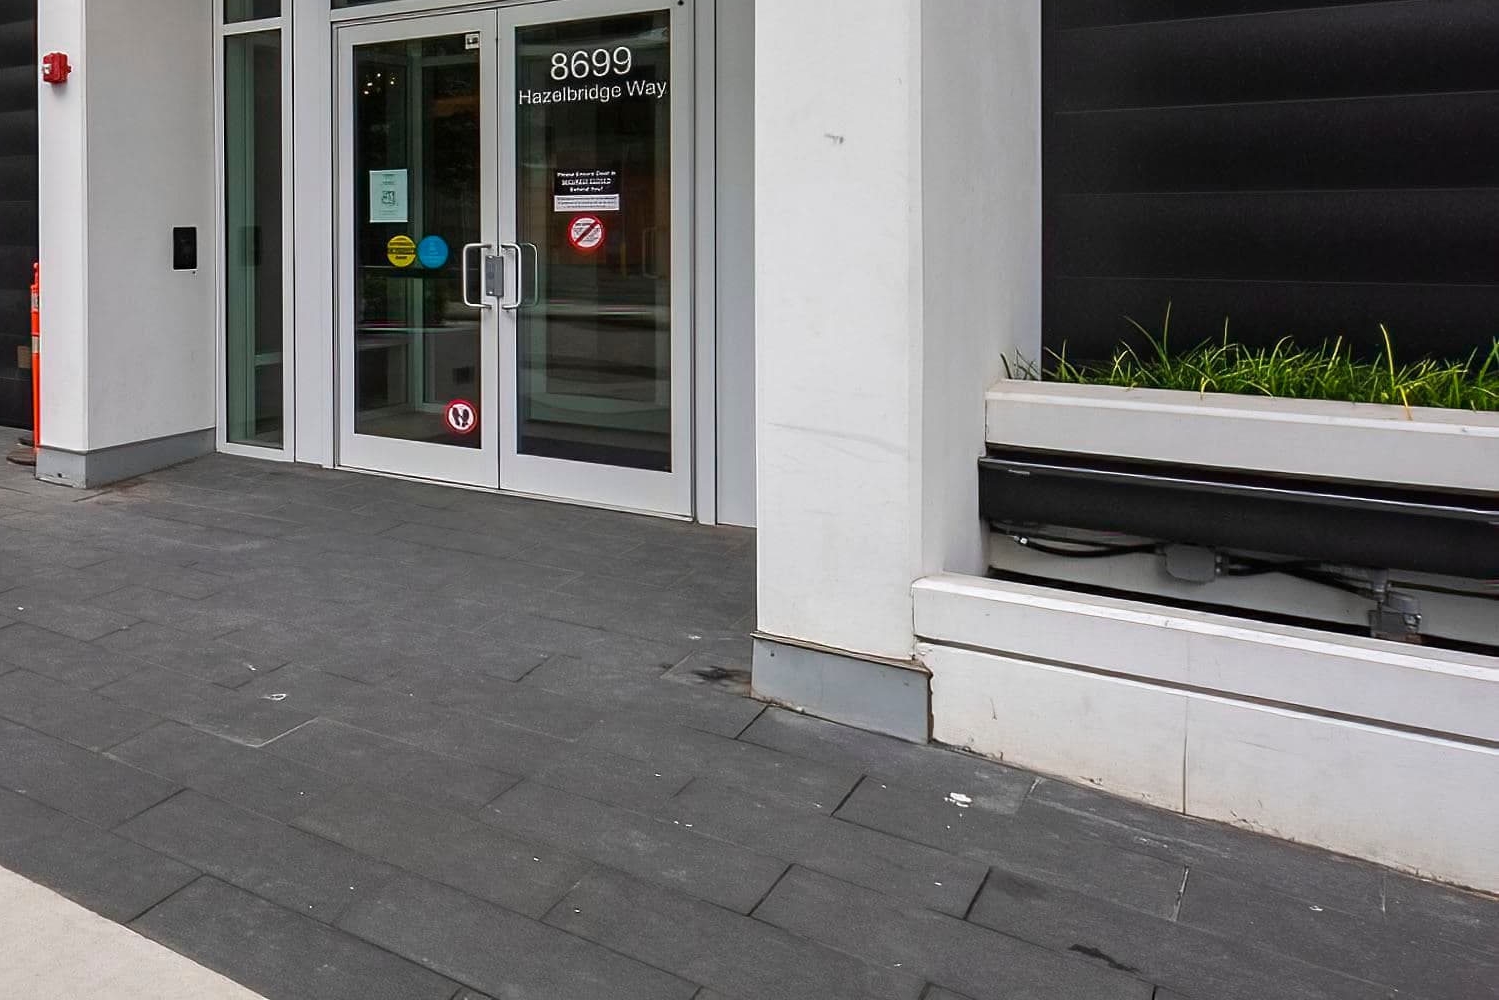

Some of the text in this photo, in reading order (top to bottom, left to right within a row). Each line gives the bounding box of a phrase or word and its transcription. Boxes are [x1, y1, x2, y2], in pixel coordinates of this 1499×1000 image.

[550, 46, 632, 80] 8699
[519, 80, 667, 105] Hazelbridge Way
